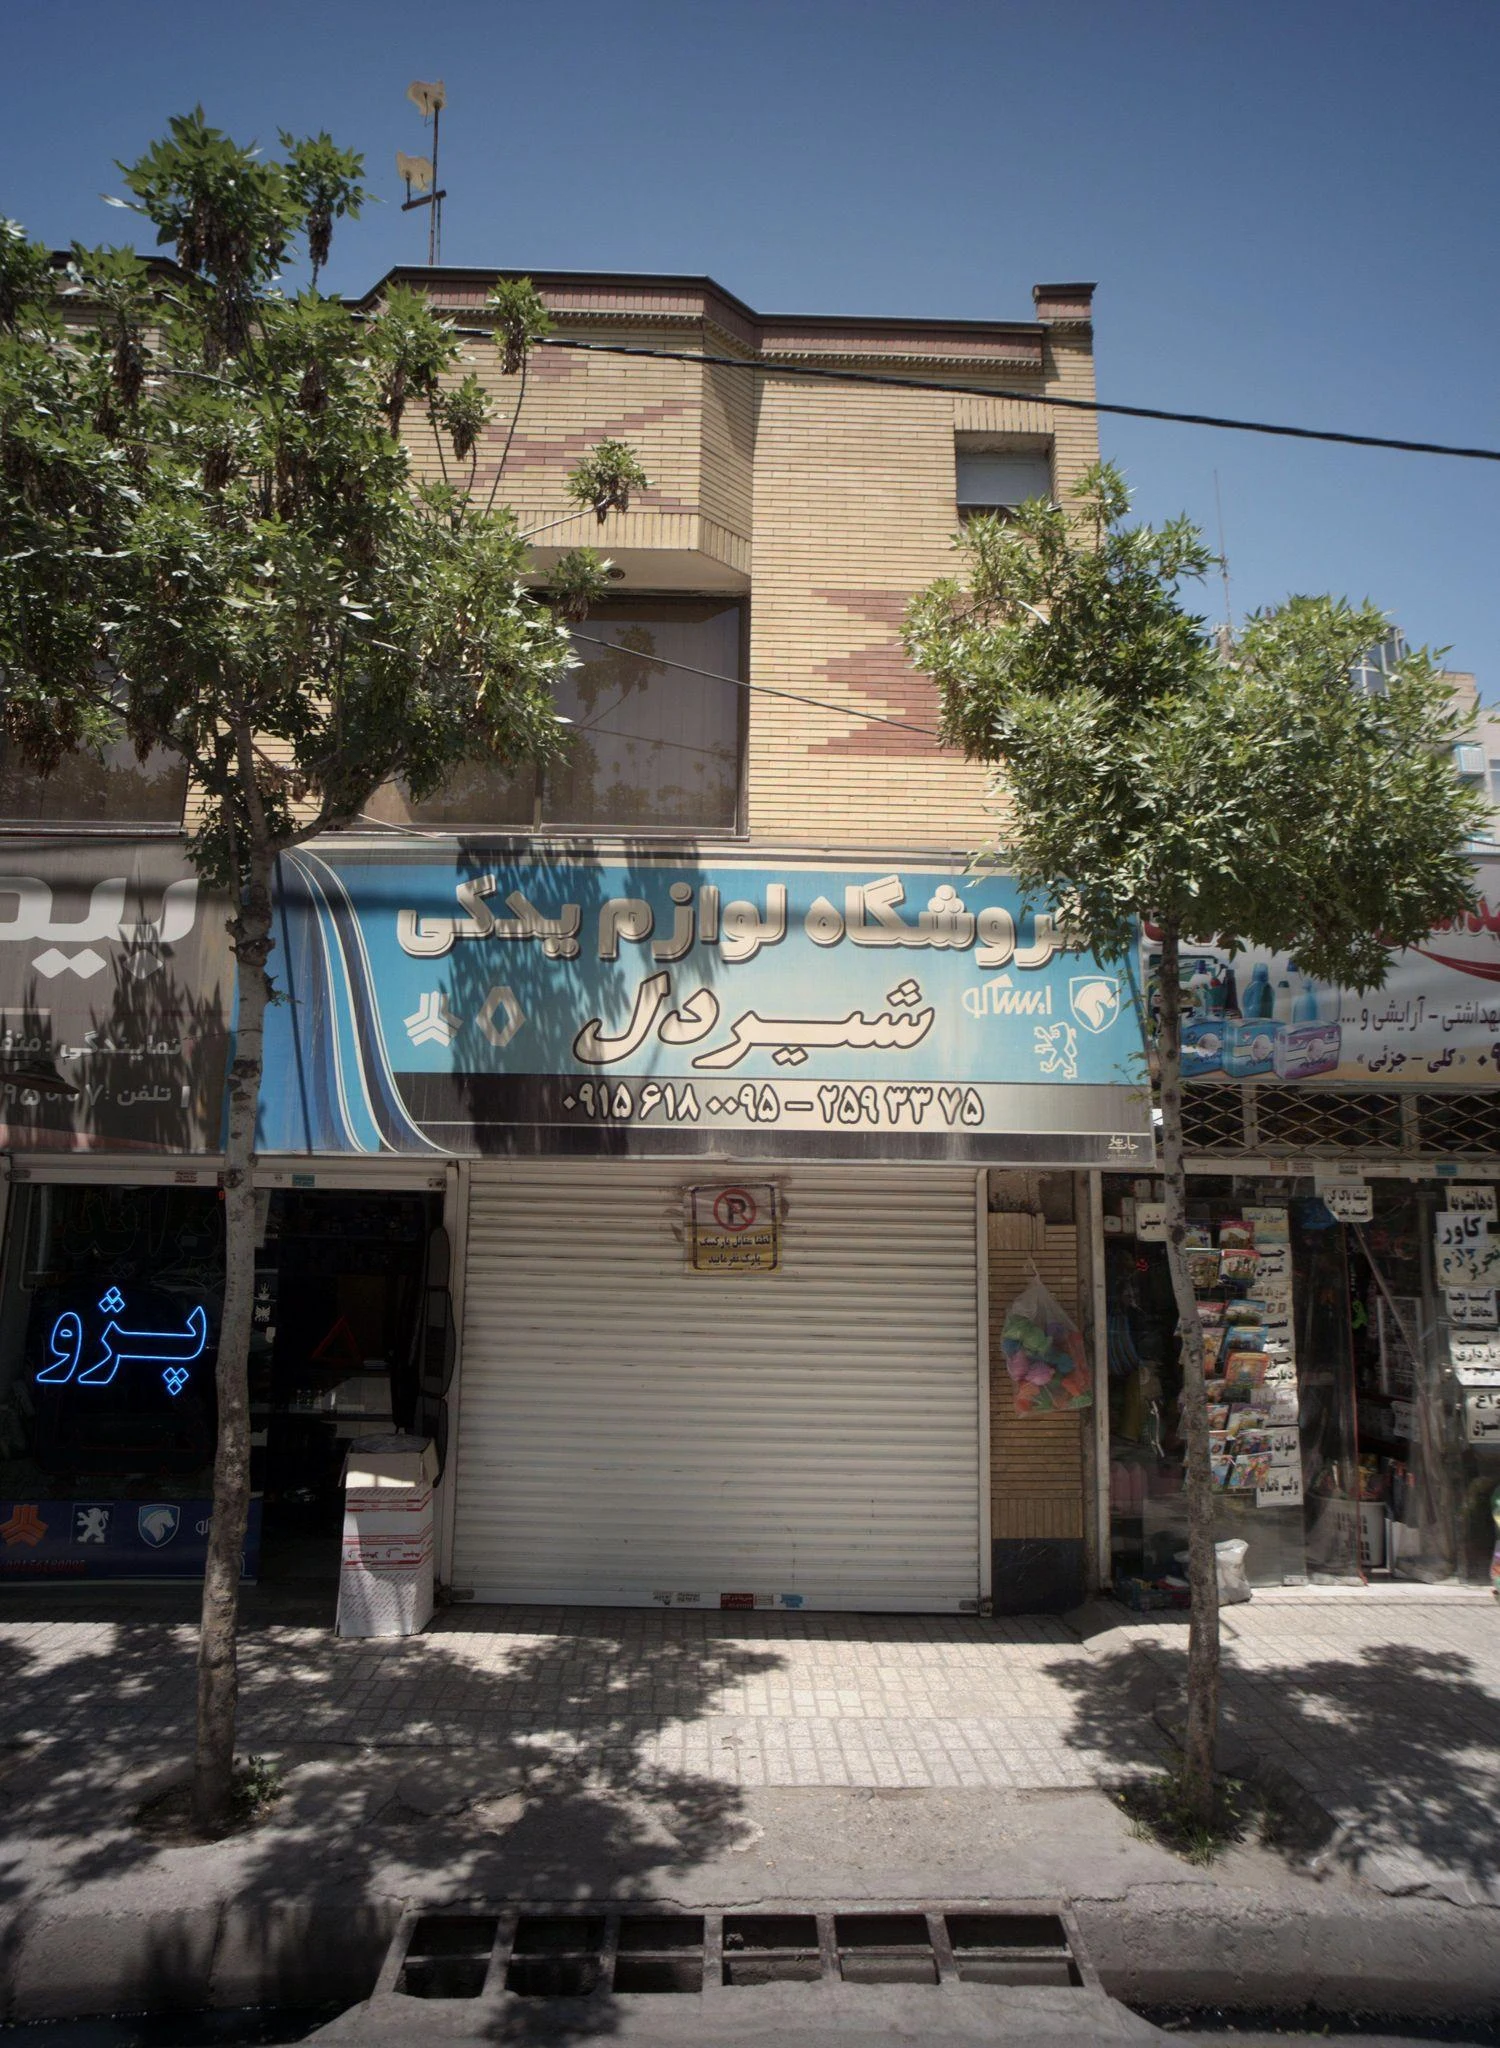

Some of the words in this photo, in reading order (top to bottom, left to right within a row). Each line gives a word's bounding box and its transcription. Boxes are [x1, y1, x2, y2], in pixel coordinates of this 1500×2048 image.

[397, 874, 581, 958] یدکی
[599, 881, 786, 961] لوازم
[572, 971, 935, 1069] شیردل
[1442, 1216, 1481, 1245] کاور
[36, 1285, 208, 1397] پژو
